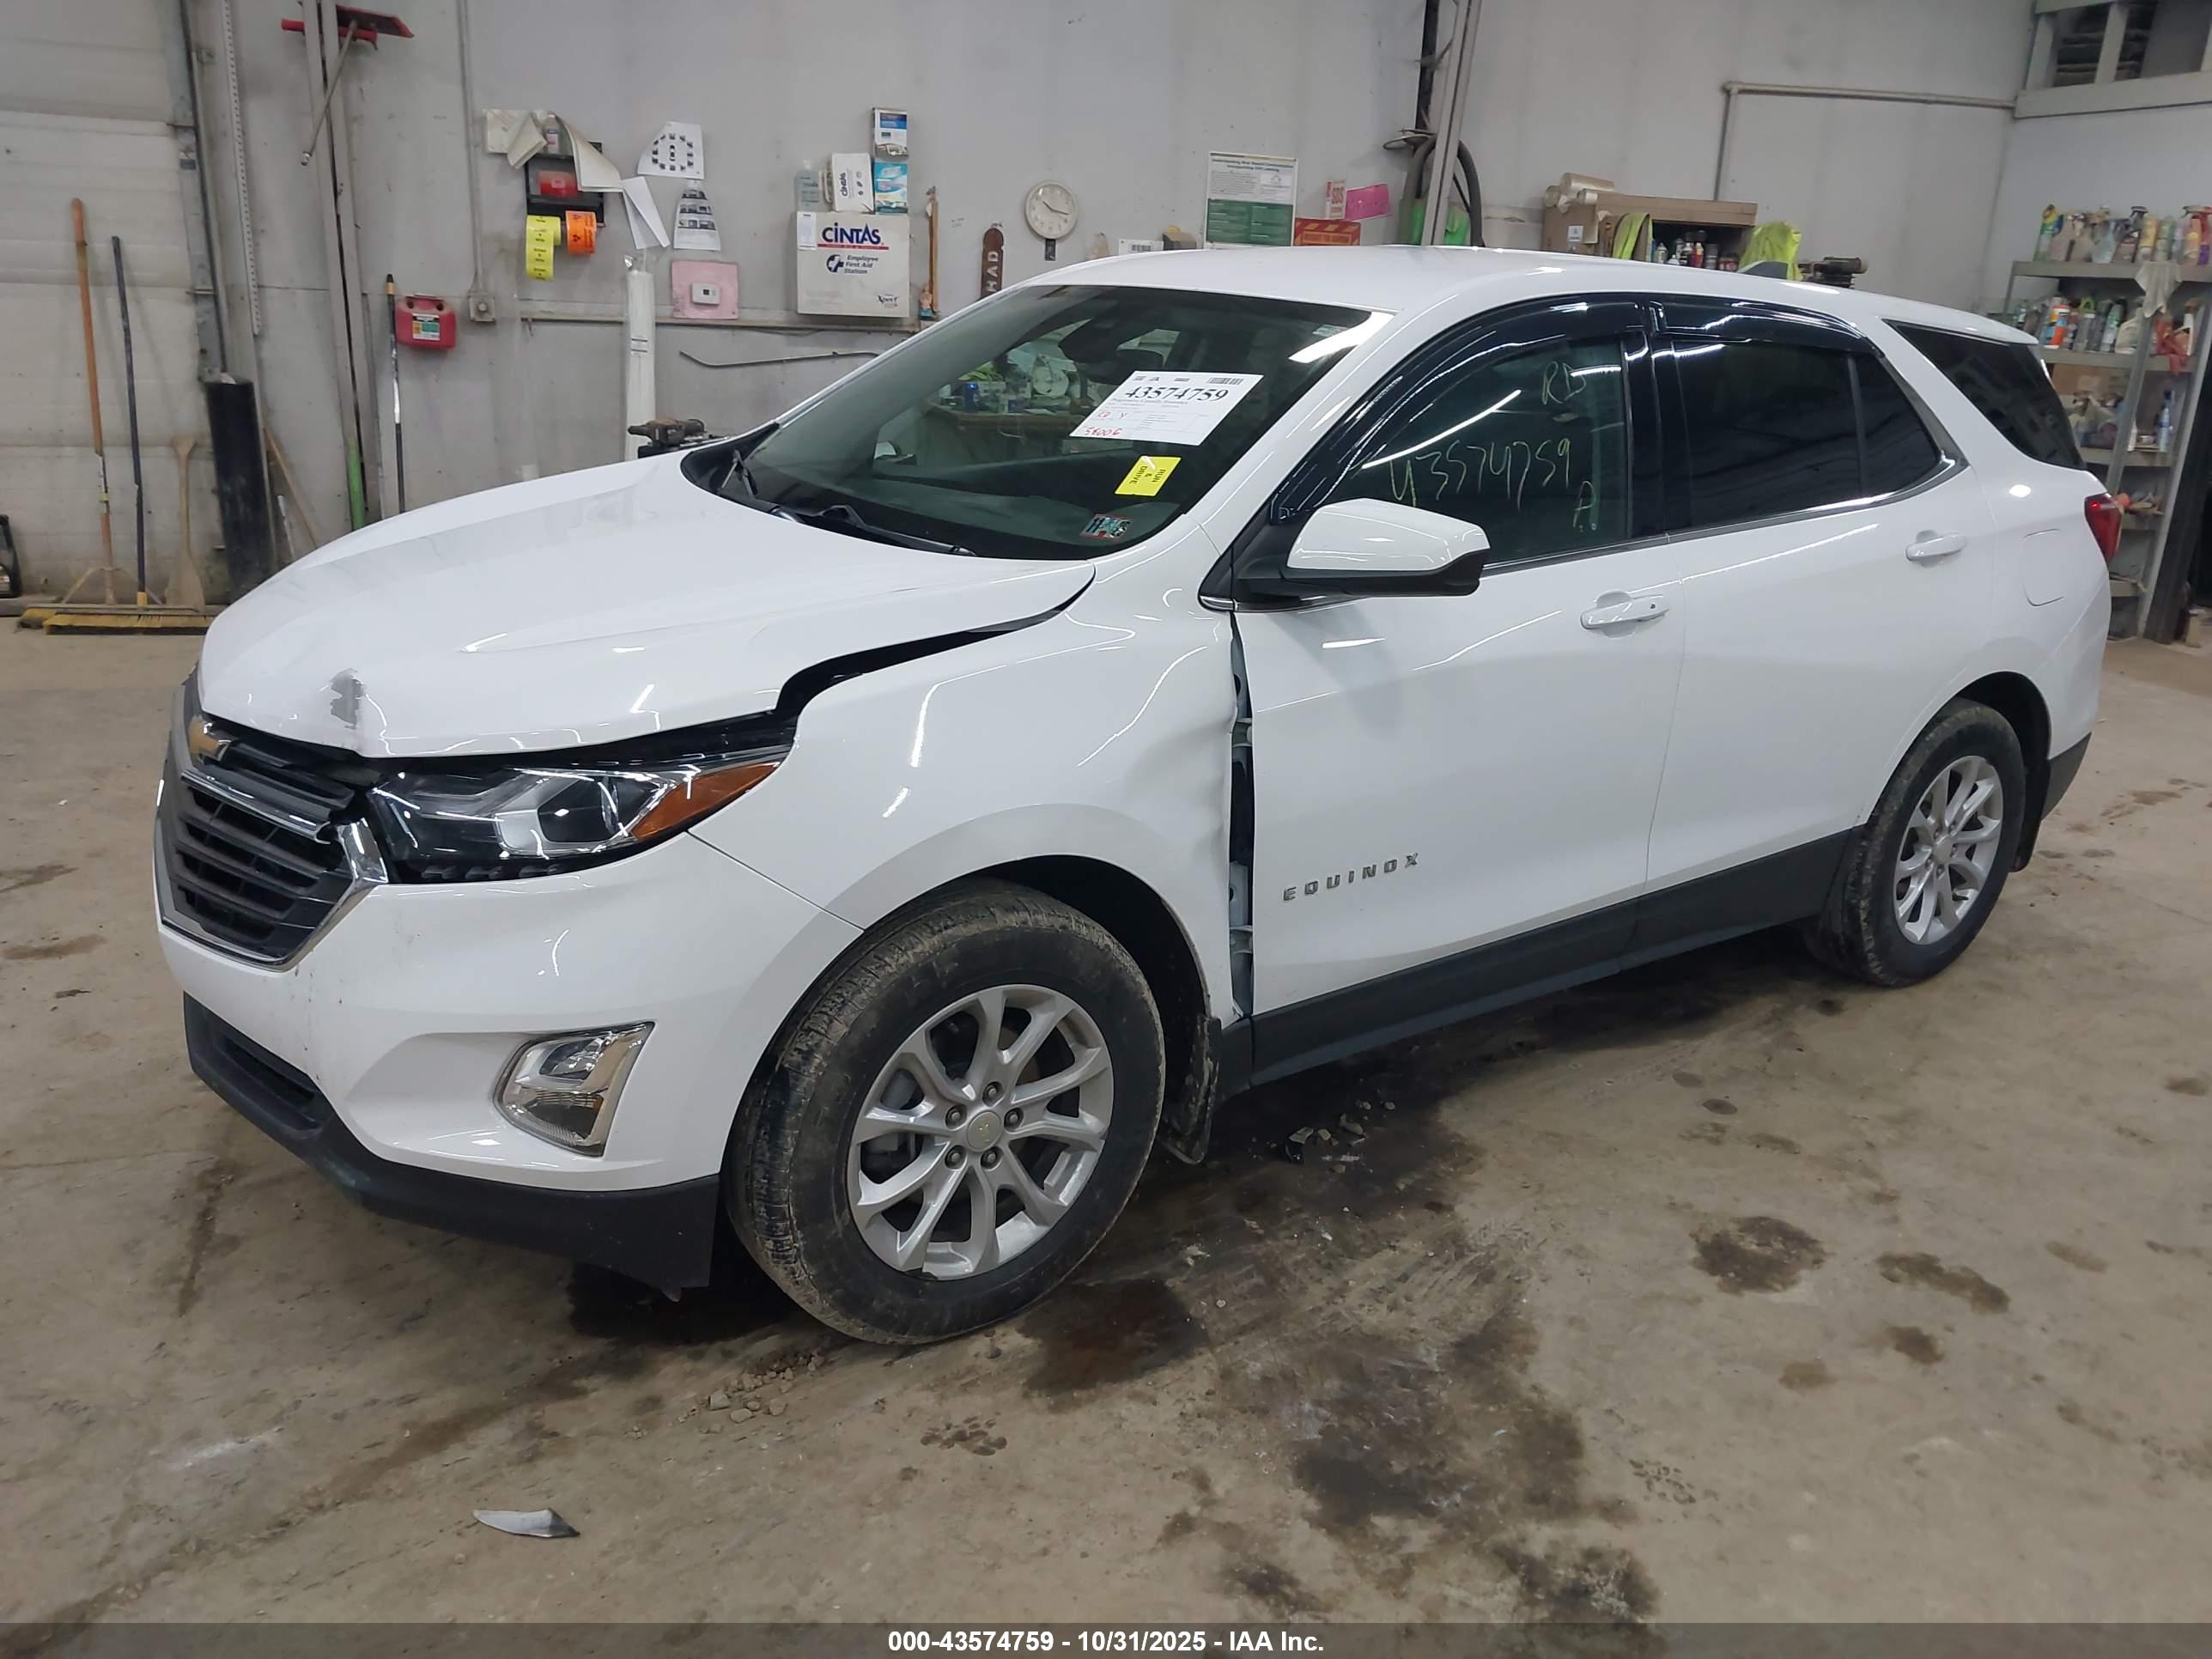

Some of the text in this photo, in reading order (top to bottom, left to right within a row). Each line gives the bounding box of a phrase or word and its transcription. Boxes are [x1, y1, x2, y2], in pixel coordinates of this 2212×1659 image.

[822, 222, 882, 245] CINTAS
[1126, 386, 1229, 402] 43574759
[1128, 465, 1148, 485] DRIVE
[1151, 469, 1166, 483] RUN
[1283, 853, 1419, 902] EQUINOX
